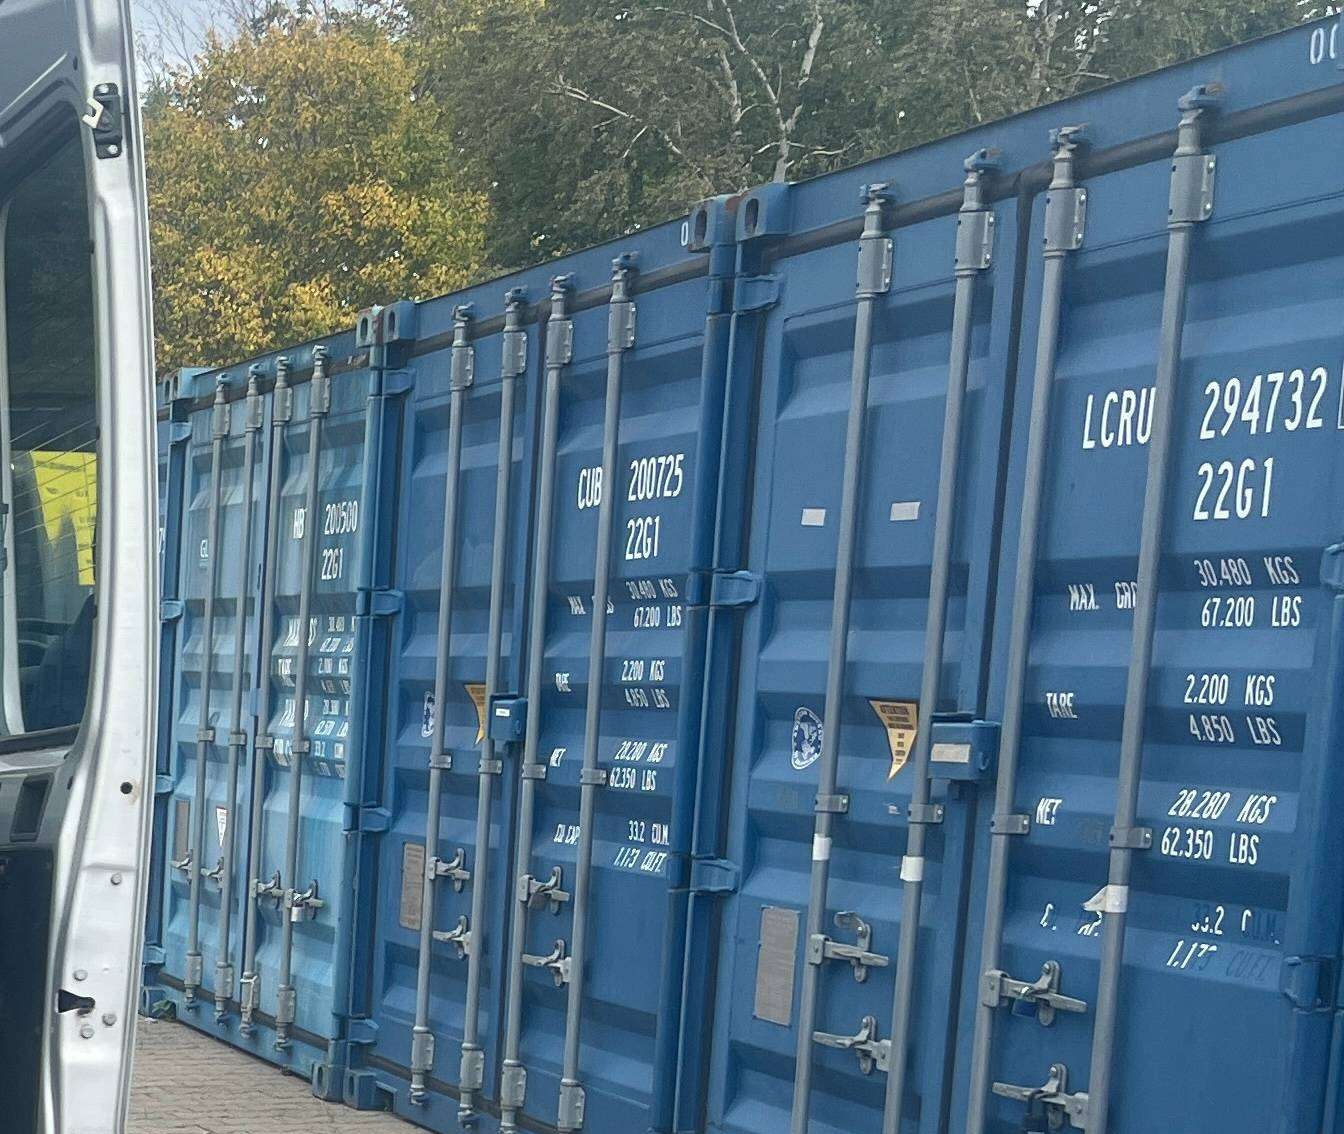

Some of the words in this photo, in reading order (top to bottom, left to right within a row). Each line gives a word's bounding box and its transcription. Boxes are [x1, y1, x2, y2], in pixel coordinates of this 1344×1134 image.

[1082, 387, 1156, 449] LCRU
[1200, 366, 1327, 440] 294732
[627, 453, 685, 501] 200725
[1193, 456, 1274, 521] 22G1
[625, 515, 660, 560] 22G1
[321, 547, 343, 580] 22G1
[1263, 556, 1300, 586] KGS
[666, 605, 682, 628] LBS
[1271, 595, 1302, 627] LBS
[649, 660, 665, 681] KGS
[651, 687, 670, 708] LBS
[1046, 692, 1078, 719] TARE
[1245, 674, 1276, 706] KGS
[1246, 715, 1282, 746] LBS
[641, 769, 657, 791] LBS
[1035, 797, 1062, 826] NET
[1236, 794, 1278, 825] KGS
[1229, 832, 1260, 866] LBS
